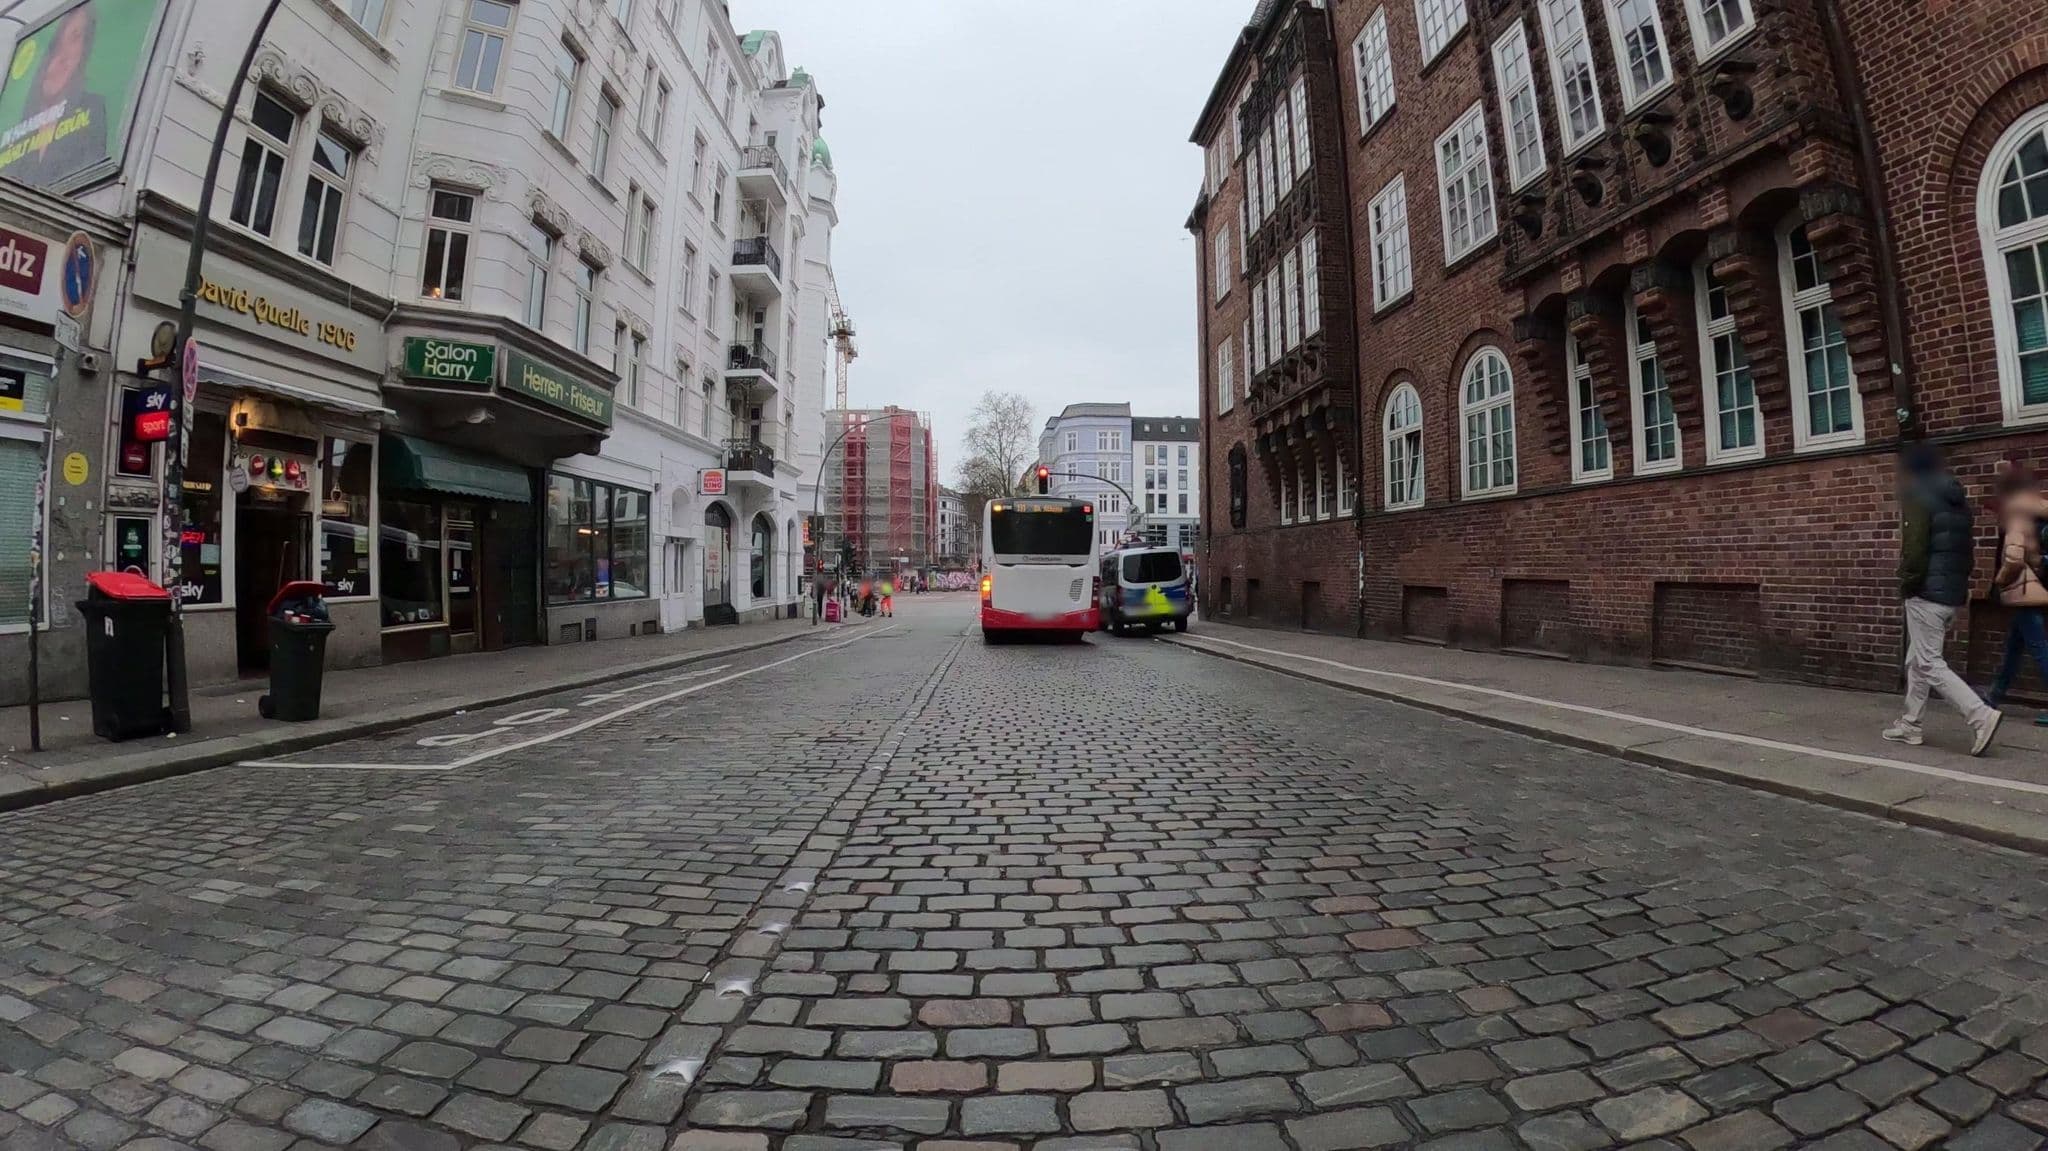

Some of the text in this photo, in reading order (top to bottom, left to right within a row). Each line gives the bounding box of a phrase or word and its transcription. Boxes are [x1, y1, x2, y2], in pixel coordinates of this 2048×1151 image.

[317, 320, 358, 351] 1906
[424, 340, 477, 363] Salon
[424, 358, 475, 381] Harry
[146, 391, 167, 410] sky
[522, 364, 563, 400] Herren
[570, 385, 604, 417] Friseur
[142, 419, 166, 435] sport
[180, 580, 204, 600] sky
[338, 577, 355, 593] sky
